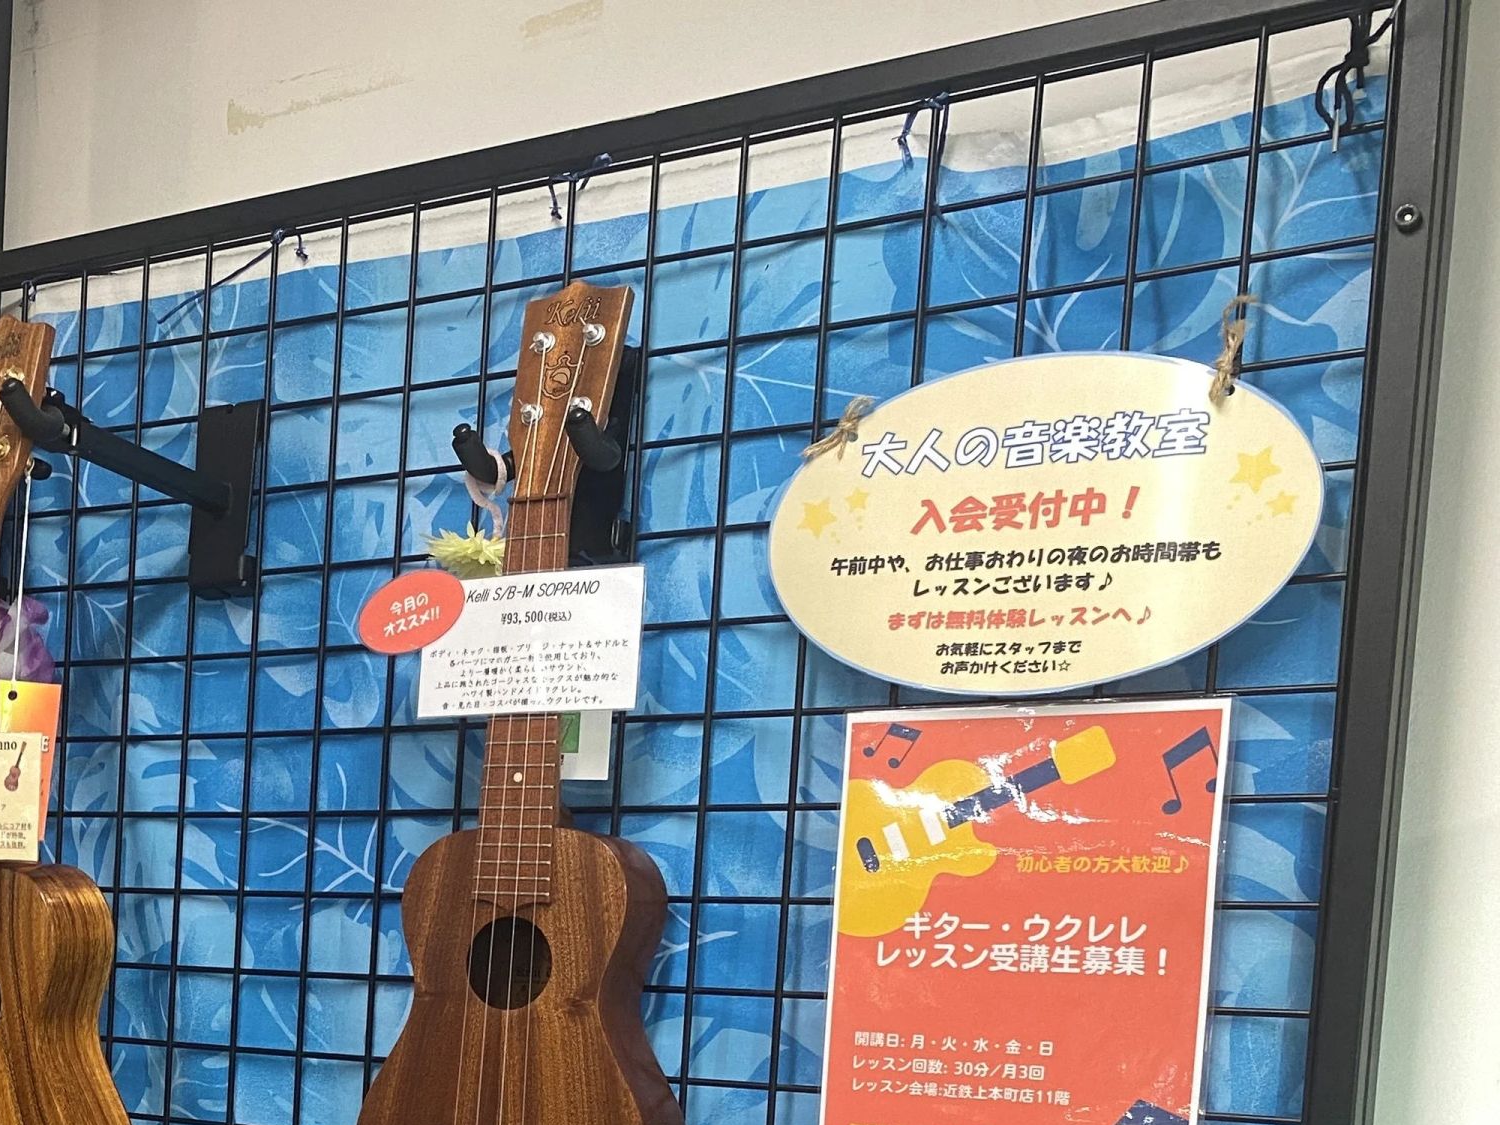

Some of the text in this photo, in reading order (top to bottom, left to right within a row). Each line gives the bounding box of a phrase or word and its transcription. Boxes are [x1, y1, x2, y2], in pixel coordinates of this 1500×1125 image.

[861, 408, 1211, 479] 大人の音楽教室
[910, 486, 1141, 536] 入会受付中！
[390, 592, 429, 615] 今月の
[492, 583, 533, 601] S/B-M
[538, 580, 600, 598] SOPRANO
[935, 640, 1082, 658] お気軽にスタッフまで
[903, 911, 1147, 944] ギター・ウクレレ
[876, 942, 1169, 977] レッスン受講生募集！
[909, 1033, 1054, 1057] 月・火・水・金・日
